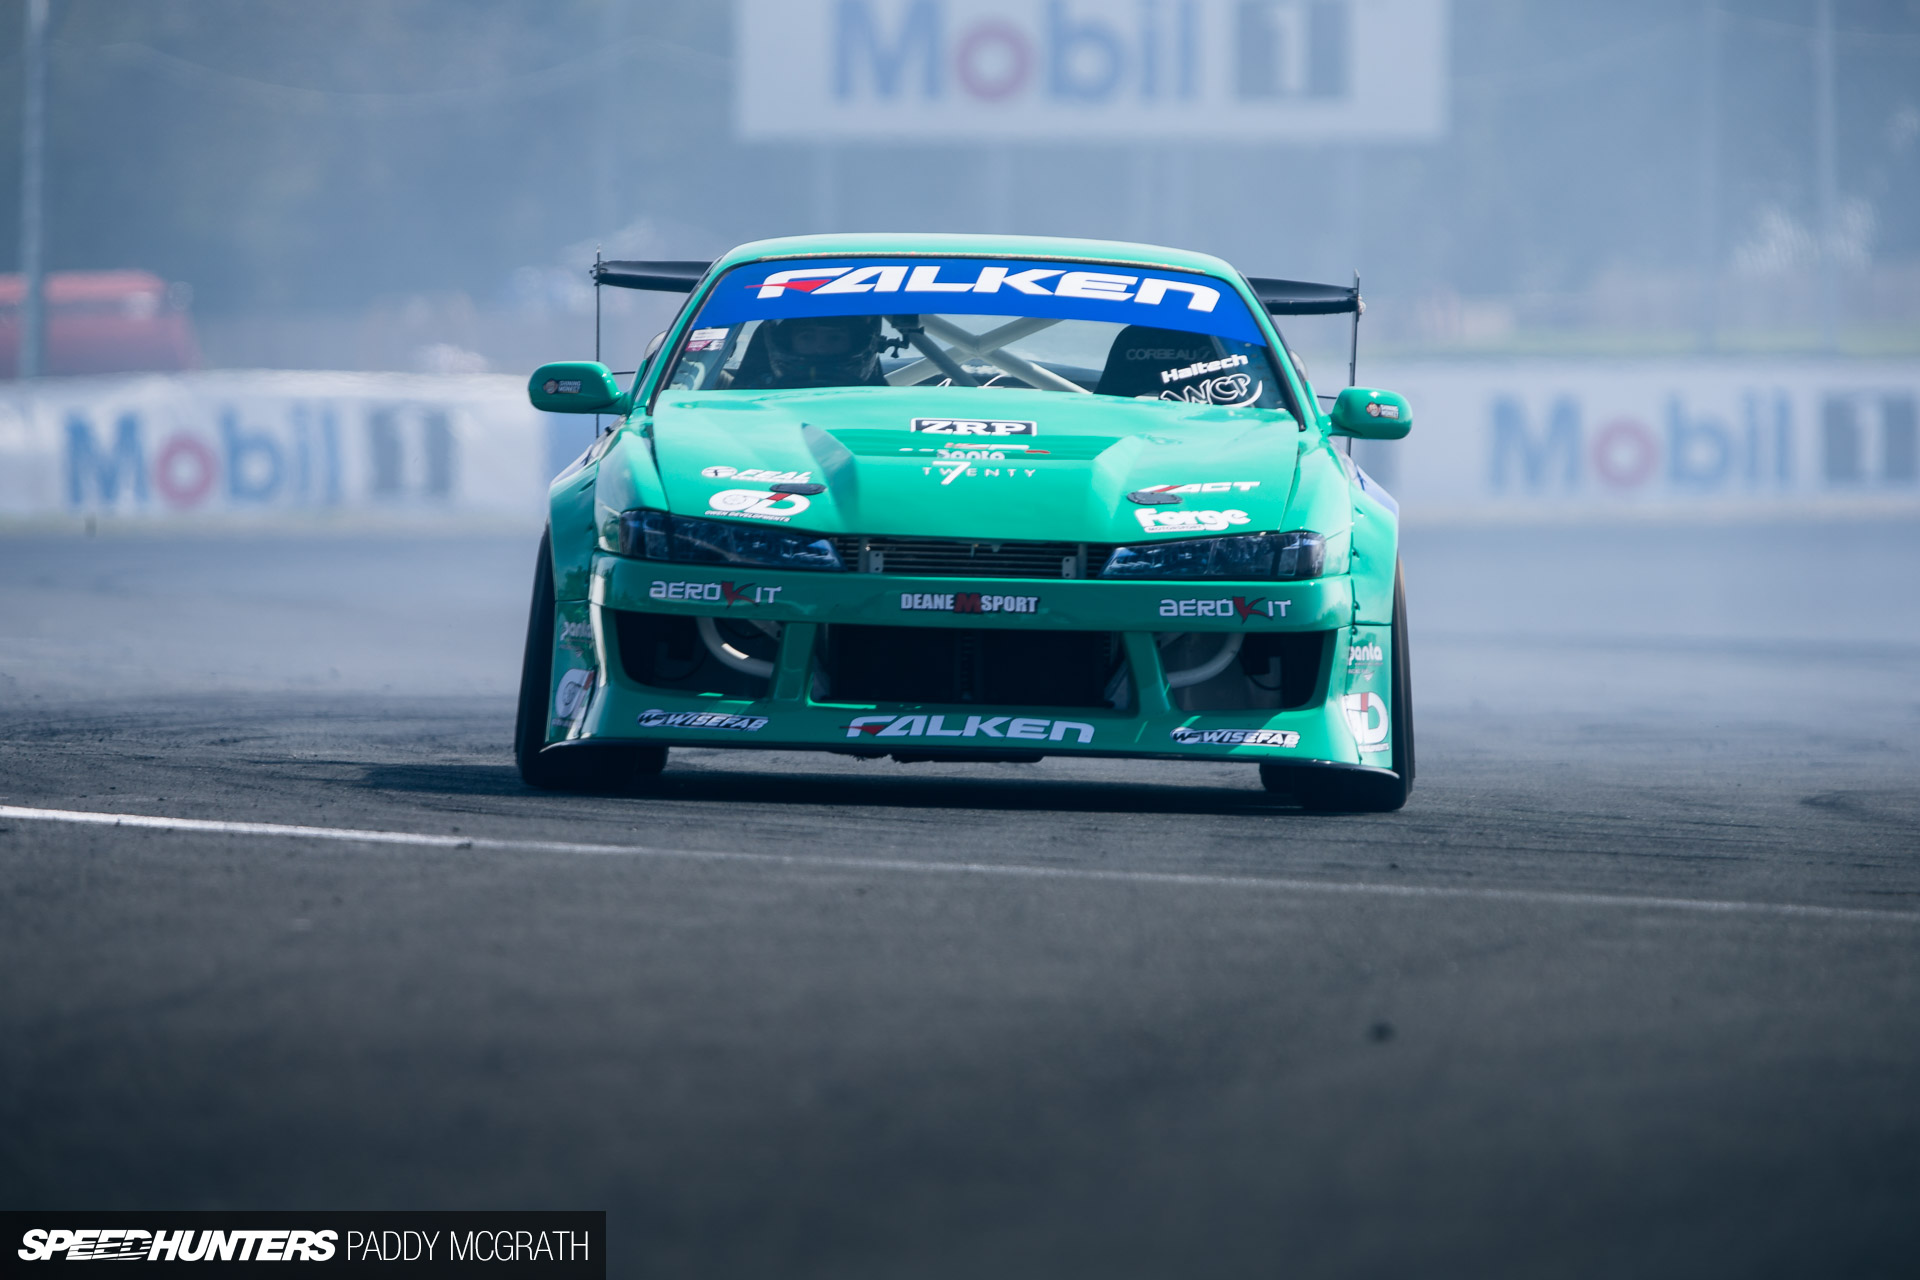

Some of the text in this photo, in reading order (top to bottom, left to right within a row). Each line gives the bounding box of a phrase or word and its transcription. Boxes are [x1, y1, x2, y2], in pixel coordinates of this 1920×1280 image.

[834, 0, 1202, 102] Mobil
[756, 266, 1221, 313] FALKEN
[1125, 348, 1198, 361] CORBEAU
[1161, 354, 1249, 384] Haltech
[921, 420, 1027, 436] ZRP
[64, 402, 341, 506] Mobil
[1487, 391, 1793, 495] Mobil
[1134, 508, 1252, 531] Forge
[667, 713, 769, 729] WISEFAB
[846, 715, 1095, 743] FALKEN
[1203, 730, 1301, 745] WISEFAB
